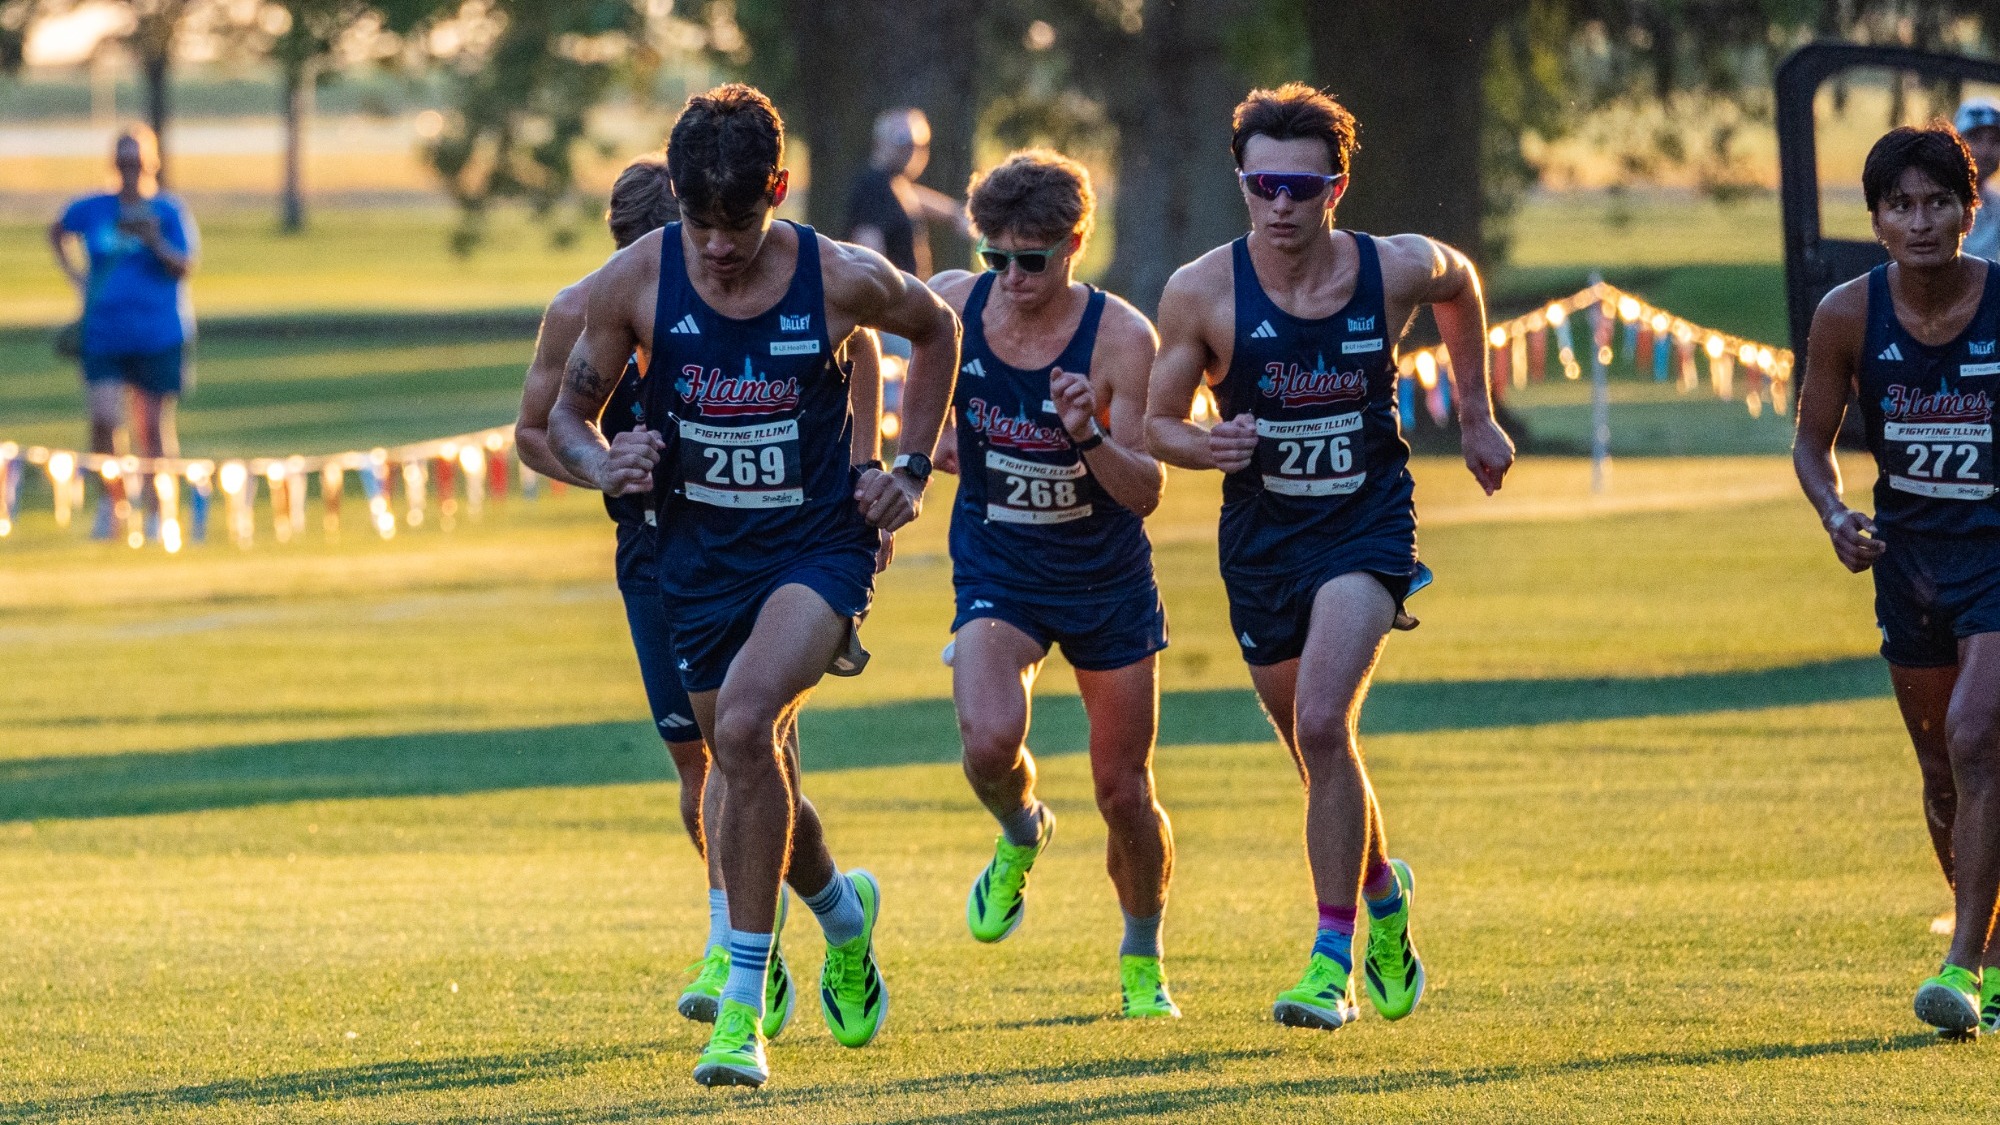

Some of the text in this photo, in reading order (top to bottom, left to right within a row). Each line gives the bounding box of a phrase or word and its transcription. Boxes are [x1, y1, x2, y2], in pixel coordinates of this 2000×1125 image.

[780, 313, 810, 331] VALLEY
[1348, 315, 1375, 332] VALLEY
[680, 364, 799, 404] Flames
[1262, 361, 1367, 398] Flames
[1884, 384, 1992, 420] Flames
[695, 423, 794, 440] FIGHTING ILLINI
[969, 397, 1064, 443] Flames
[1269, 415, 1359, 433] FIGHTING ILLINI
[1898, 427, 1950, 436] FIGHTING
[1953, 427, 1987, 437] ILLINI
[703, 446, 785, 486] 269
[999, 458, 1047, 475] FIGHTING
[1278, 435, 1353, 475] 276
[1906, 443, 1980, 479] 272
[1005, 475, 1077, 508] 268
